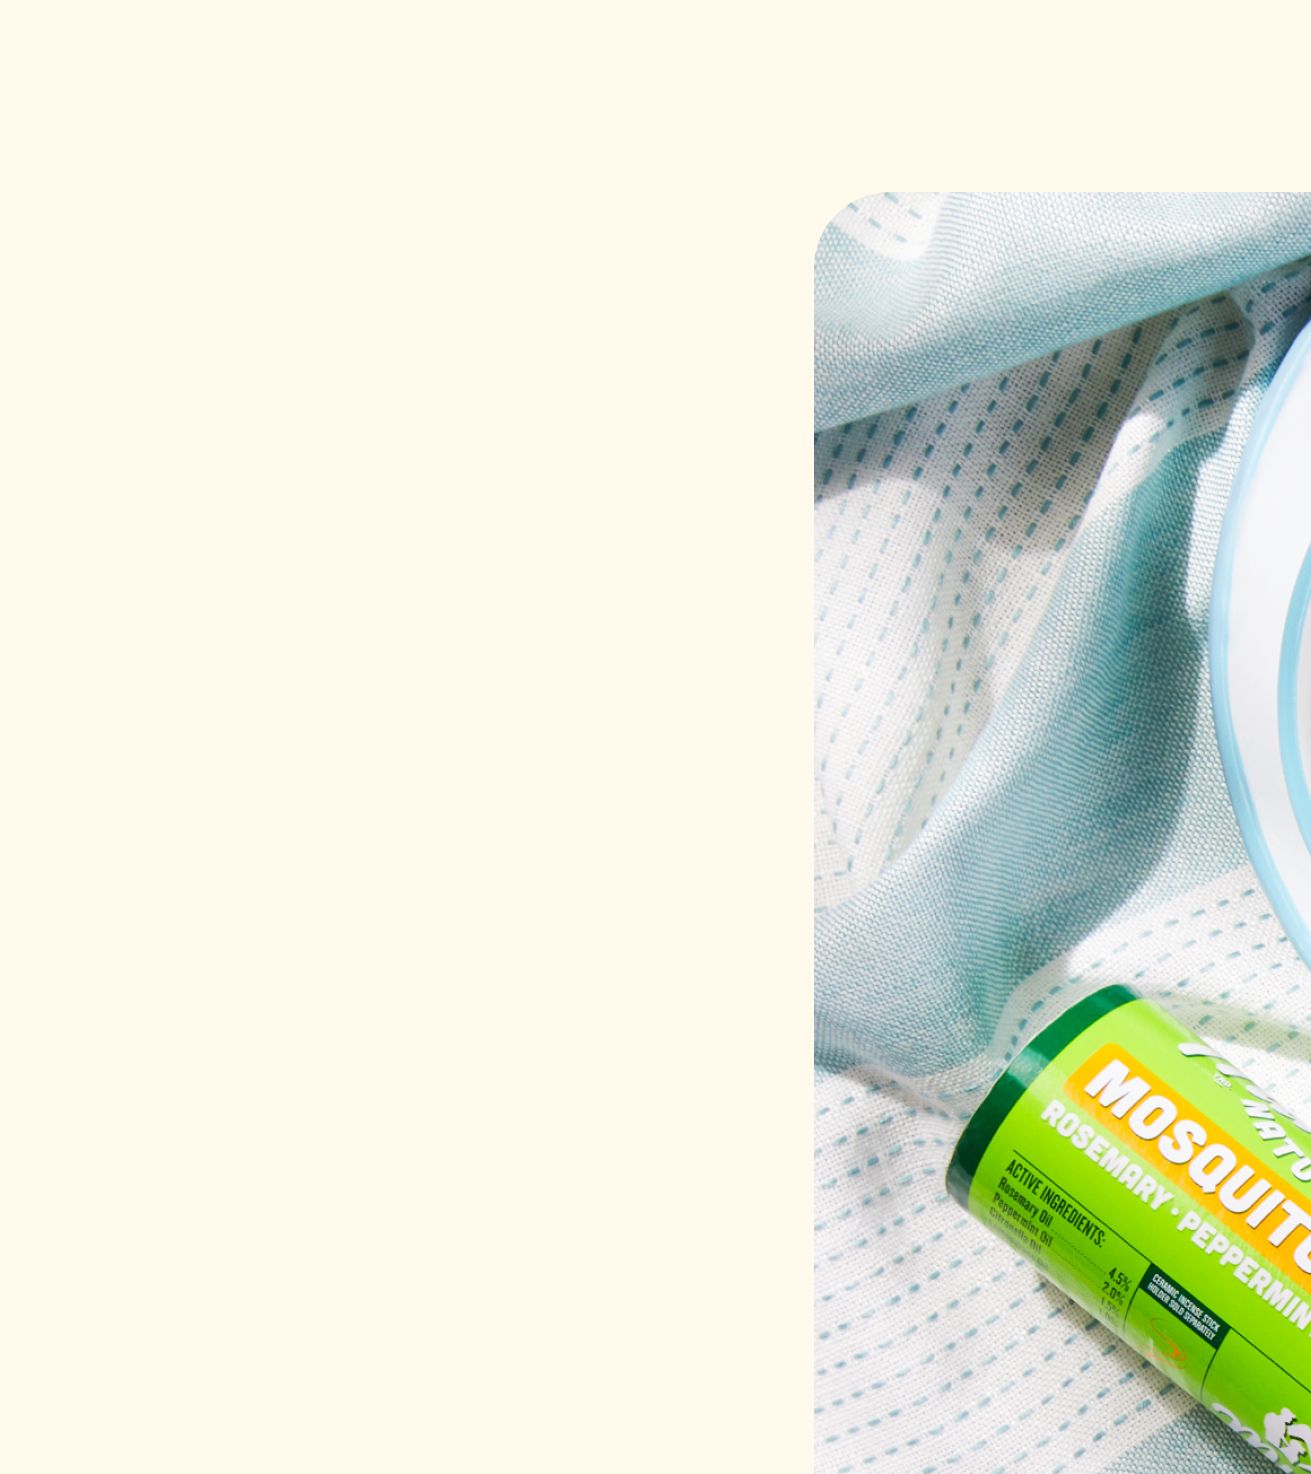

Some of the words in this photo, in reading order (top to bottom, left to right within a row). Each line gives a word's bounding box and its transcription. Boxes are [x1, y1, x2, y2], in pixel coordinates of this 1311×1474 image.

[1005, 1158, 1044, 1195] ACTIVE
[1038, 1185, 1109, 1248] INGREDIENTS:
[1039, 1097, 1173, 1214] ROSEMARY
[989, 1192, 1041, 1238] Peppermint
[1037, 1230, 1054, 1247] Oil
[1099, 1280, 1127, 1306] 2.0%
[995, 1176, 1041, 1218] Rosemary
[1037, 1209, 1054, 1227] Oil
[1107, 1266, 1134, 1291] 4.5%
